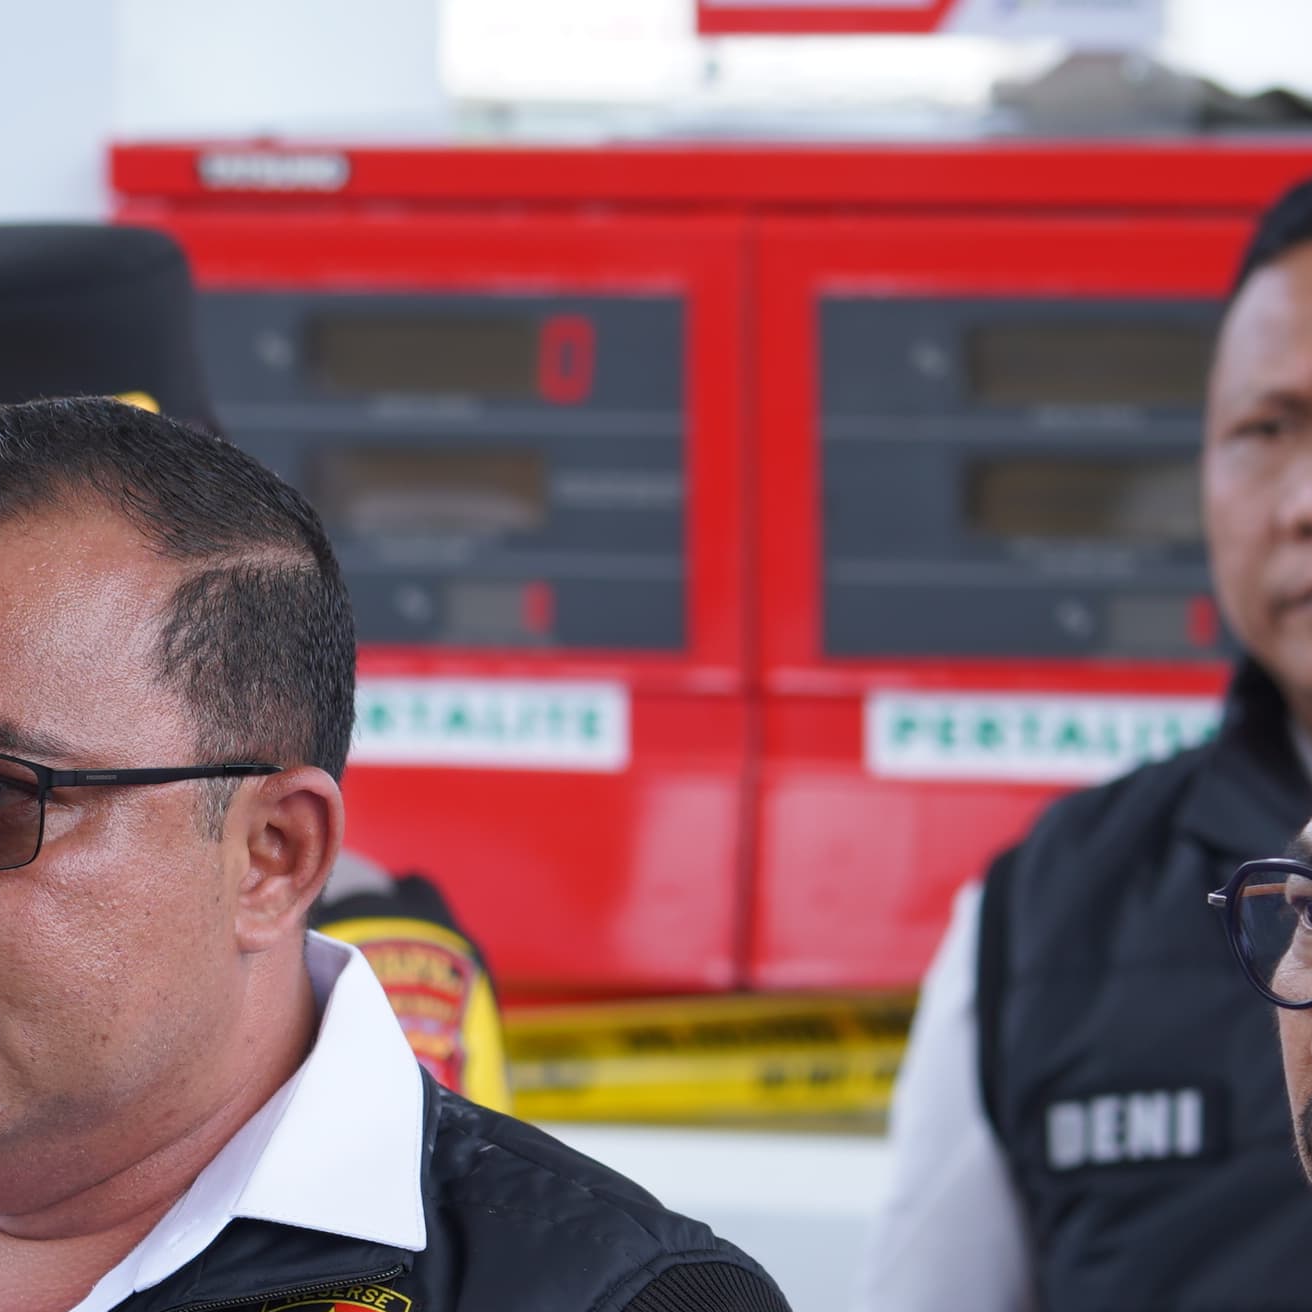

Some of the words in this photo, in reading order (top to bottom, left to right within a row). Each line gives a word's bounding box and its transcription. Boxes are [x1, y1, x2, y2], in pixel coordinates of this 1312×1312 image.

[536, 313, 596, 406] 0
[364, 690, 602, 744] RTALITE
[1046, 1089, 1202, 1170] DENI
